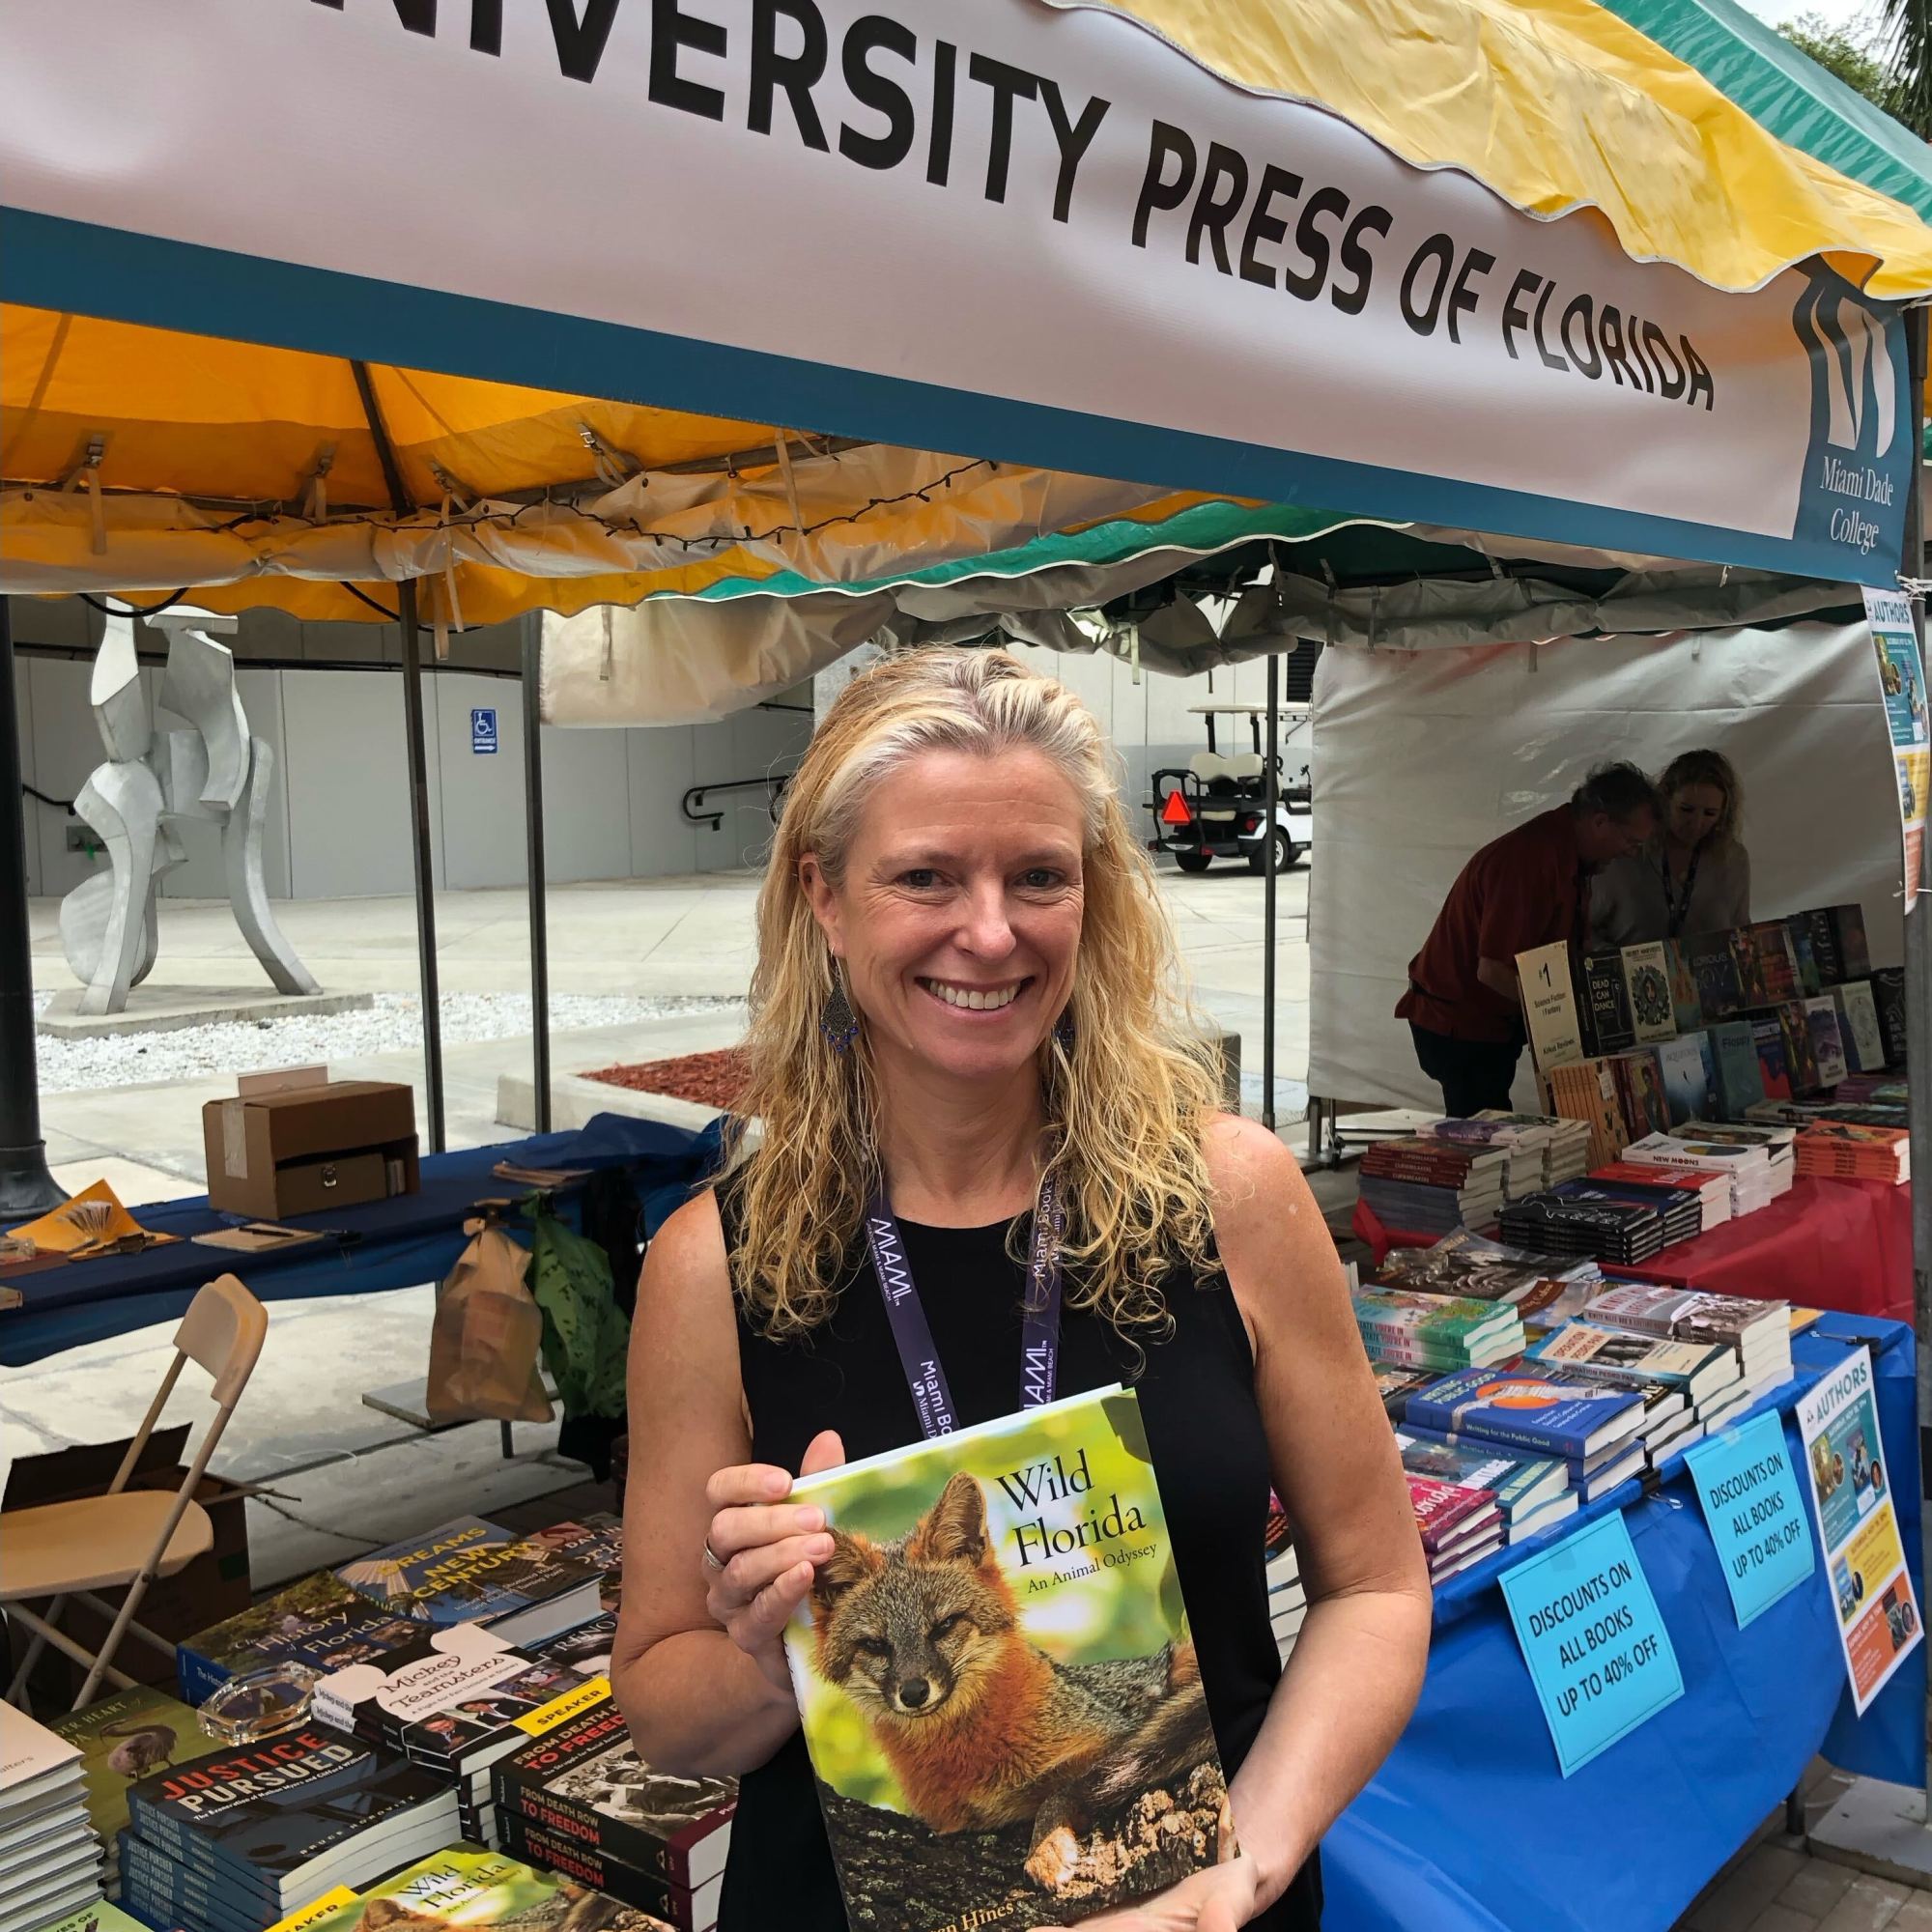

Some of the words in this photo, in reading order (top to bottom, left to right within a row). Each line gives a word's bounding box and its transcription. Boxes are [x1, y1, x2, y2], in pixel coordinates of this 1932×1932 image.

[311, 0, 1110, 223] VERSITY
[1132, 120, 1393, 315] PRESS
[1400, 233, 1495, 344] OF
[1502, 269, 1715, 411] FLORIDA
[1820, 456, 1864, 498] Miami
[1864, 469, 1893, 507] Dade
[1831, 508, 1880, 555] College
[1874, 600, 1910, 624] AUTHORS
[1592, 980, 1609, 990] DEAD
[1594, 1001, 1616, 1011] DANCE
[1596, 989, 1610, 1000] CAN
[1653, 1155, 1669, 1164] NEW
[1032, 1229, 1048, 1278] Miami
[882, 1282, 892, 1302] BEACH
[920, 1359, 946, 1412] Miami
[1562, 1365, 1598, 1377] OPERATION
[1599, 1369, 1621, 1380] PEDRO
[1621, 1373, 1634, 1382] PAN
[1816, 1361, 1867, 1424] AUTHORS
[917, 1397, 933, 1429] Miami
[1465, 1423, 1490, 1436] Writing
[1491, 1428, 1499, 1436] for
[1499, 1431, 1510, 1439] the
[1511, 1432, 1532, 1444] Public
[1533, 1437, 1550, 1447] Good
[995, 1448, 1094, 1513] Wild
[1710, 1464, 1767, 1510] DISCOUNTS
[1767, 1452, 1783, 1476] ON
[1013, 1494, 1147, 1568] Florida
[1732, 1516, 1751, 1538] ALL
[1751, 1491, 1784, 1528] BOOKS
[379, 1527, 487, 1577] DREAMS
[565, 1534, 597, 1549] DAY
[601, 1525, 623, 1536] IN
[1732, 1553, 1748, 1579] UP
[1747, 1543, 1763, 1569] TO
[1764, 1530, 1784, 1561] 40%
[1784, 1518, 1802, 1544] OFF
[412, 1541, 540, 1599] CENTURY
[423, 1546, 489, 1577] NEW
[1027, 1574, 1048, 1594] An
[1051, 1557, 1101, 1587] Animal
[1102, 1542, 1157, 1572] Odyssey
[1529, 1574, 1609, 1638] DISCOUNTS
[1610, 1559, 1632, 1591] ON
[255, 1611, 348, 1652] History
[302, 1615, 395, 1654] Florida
[1559, 1639, 1586, 1669] ALL
[1584, 1605, 1634, 1651] BOOKS
[377, 1655, 461, 1693] Mickey
[389, 1657, 506, 1709] Teamsters
[418, 1704, 435, 1715] Fight
[449, 1690, 461, 1699] Fair
[462, 1680, 488, 1694] Unions
[497, 1662, 520, 1677] Disney
[423, 1676, 440, 1687] and
[442, 1670, 455, 1680] the
[1557, 1689, 1578, 1718] UP
[1578, 1673, 1602, 1703] TO
[1605, 1653, 1633, 1690] 40%
[1634, 1634, 1660, 1667] OFF
[82, 1700, 127, 1724] HEART
[317, 1706, 334, 1721] Mickey
[334, 1717, 345, 1725] and
[319, 1689, 335, 1705] Mickey
[335, 1699, 345, 1709] and
[537, 1690, 603, 1725] SPEAKER
[512, 1738, 557, 1767] FROM
[558, 1714, 609, 1749] DEATH
[524, 1752, 558, 1772] TO
[559, 1715, 626, 1752] FREED
[554, 1755, 578, 1771] Struggle
[587, 1743, 604, 1754] Racial
[603, 1733, 621, 1746] Justice
[161, 1732, 329, 1800] JUSTICE
[177, 1745, 355, 1814] PURSUED
[193, 1810, 207, 1822] The
[208, 1797, 250, 1816] Exoneration
[257, 1787, 284, 1801] Nathan
[284, 1780, 304, 1794] Myers
[304, 1776, 316, 1785] and
[317, 1764, 343, 1780] Clifford
[343, 1750, 372, 1770] Williams
[137, 1799, 156, 1816] JUSTICE
[156, 1809, 180, 1832] PURSUED
[299, 1831, 344, 1855] BRUCE
[350, 1795, 416, 1829] HOROVITZ
[520, 1785, 545, 1804] FROM
[547, 1795, 576, 1817] DEATH
[577, 1807, 599, 1827] ROW
[521, 1799, 539, 1817] TO
[540, 1807, 601, 1846] FREEDOM
[139, 1811, 159, 1832] JUSTICE
[159, 1824, 182, 1846] PURSUED
[141, 1828, 160, 1847] JUSTICE
[161, 1839, 184, 1861] PURSUED
[525, 1827, 550, 1846] FROM
[551, 1836, 580, 1860] DEATH
[581, 1851, 603, 1870] ROW
[128, 1838, 148, 1856] JUSTICE
[149, 1851, 173, 1873] PURSUED
[526, 1839, 544, 1859] TO
[545, 1849, 605, 1888] FREEDOM
[399, 1864, 462, 1895] Wild
[422, 1864, 507, 1909] Florida
[286, 1904, 340, 1932] AKER
[447, 1904, 461, 1914] An
[461, 1888, 490, 1906] Animal
[960, 1901, 1014, 1931] Hines
